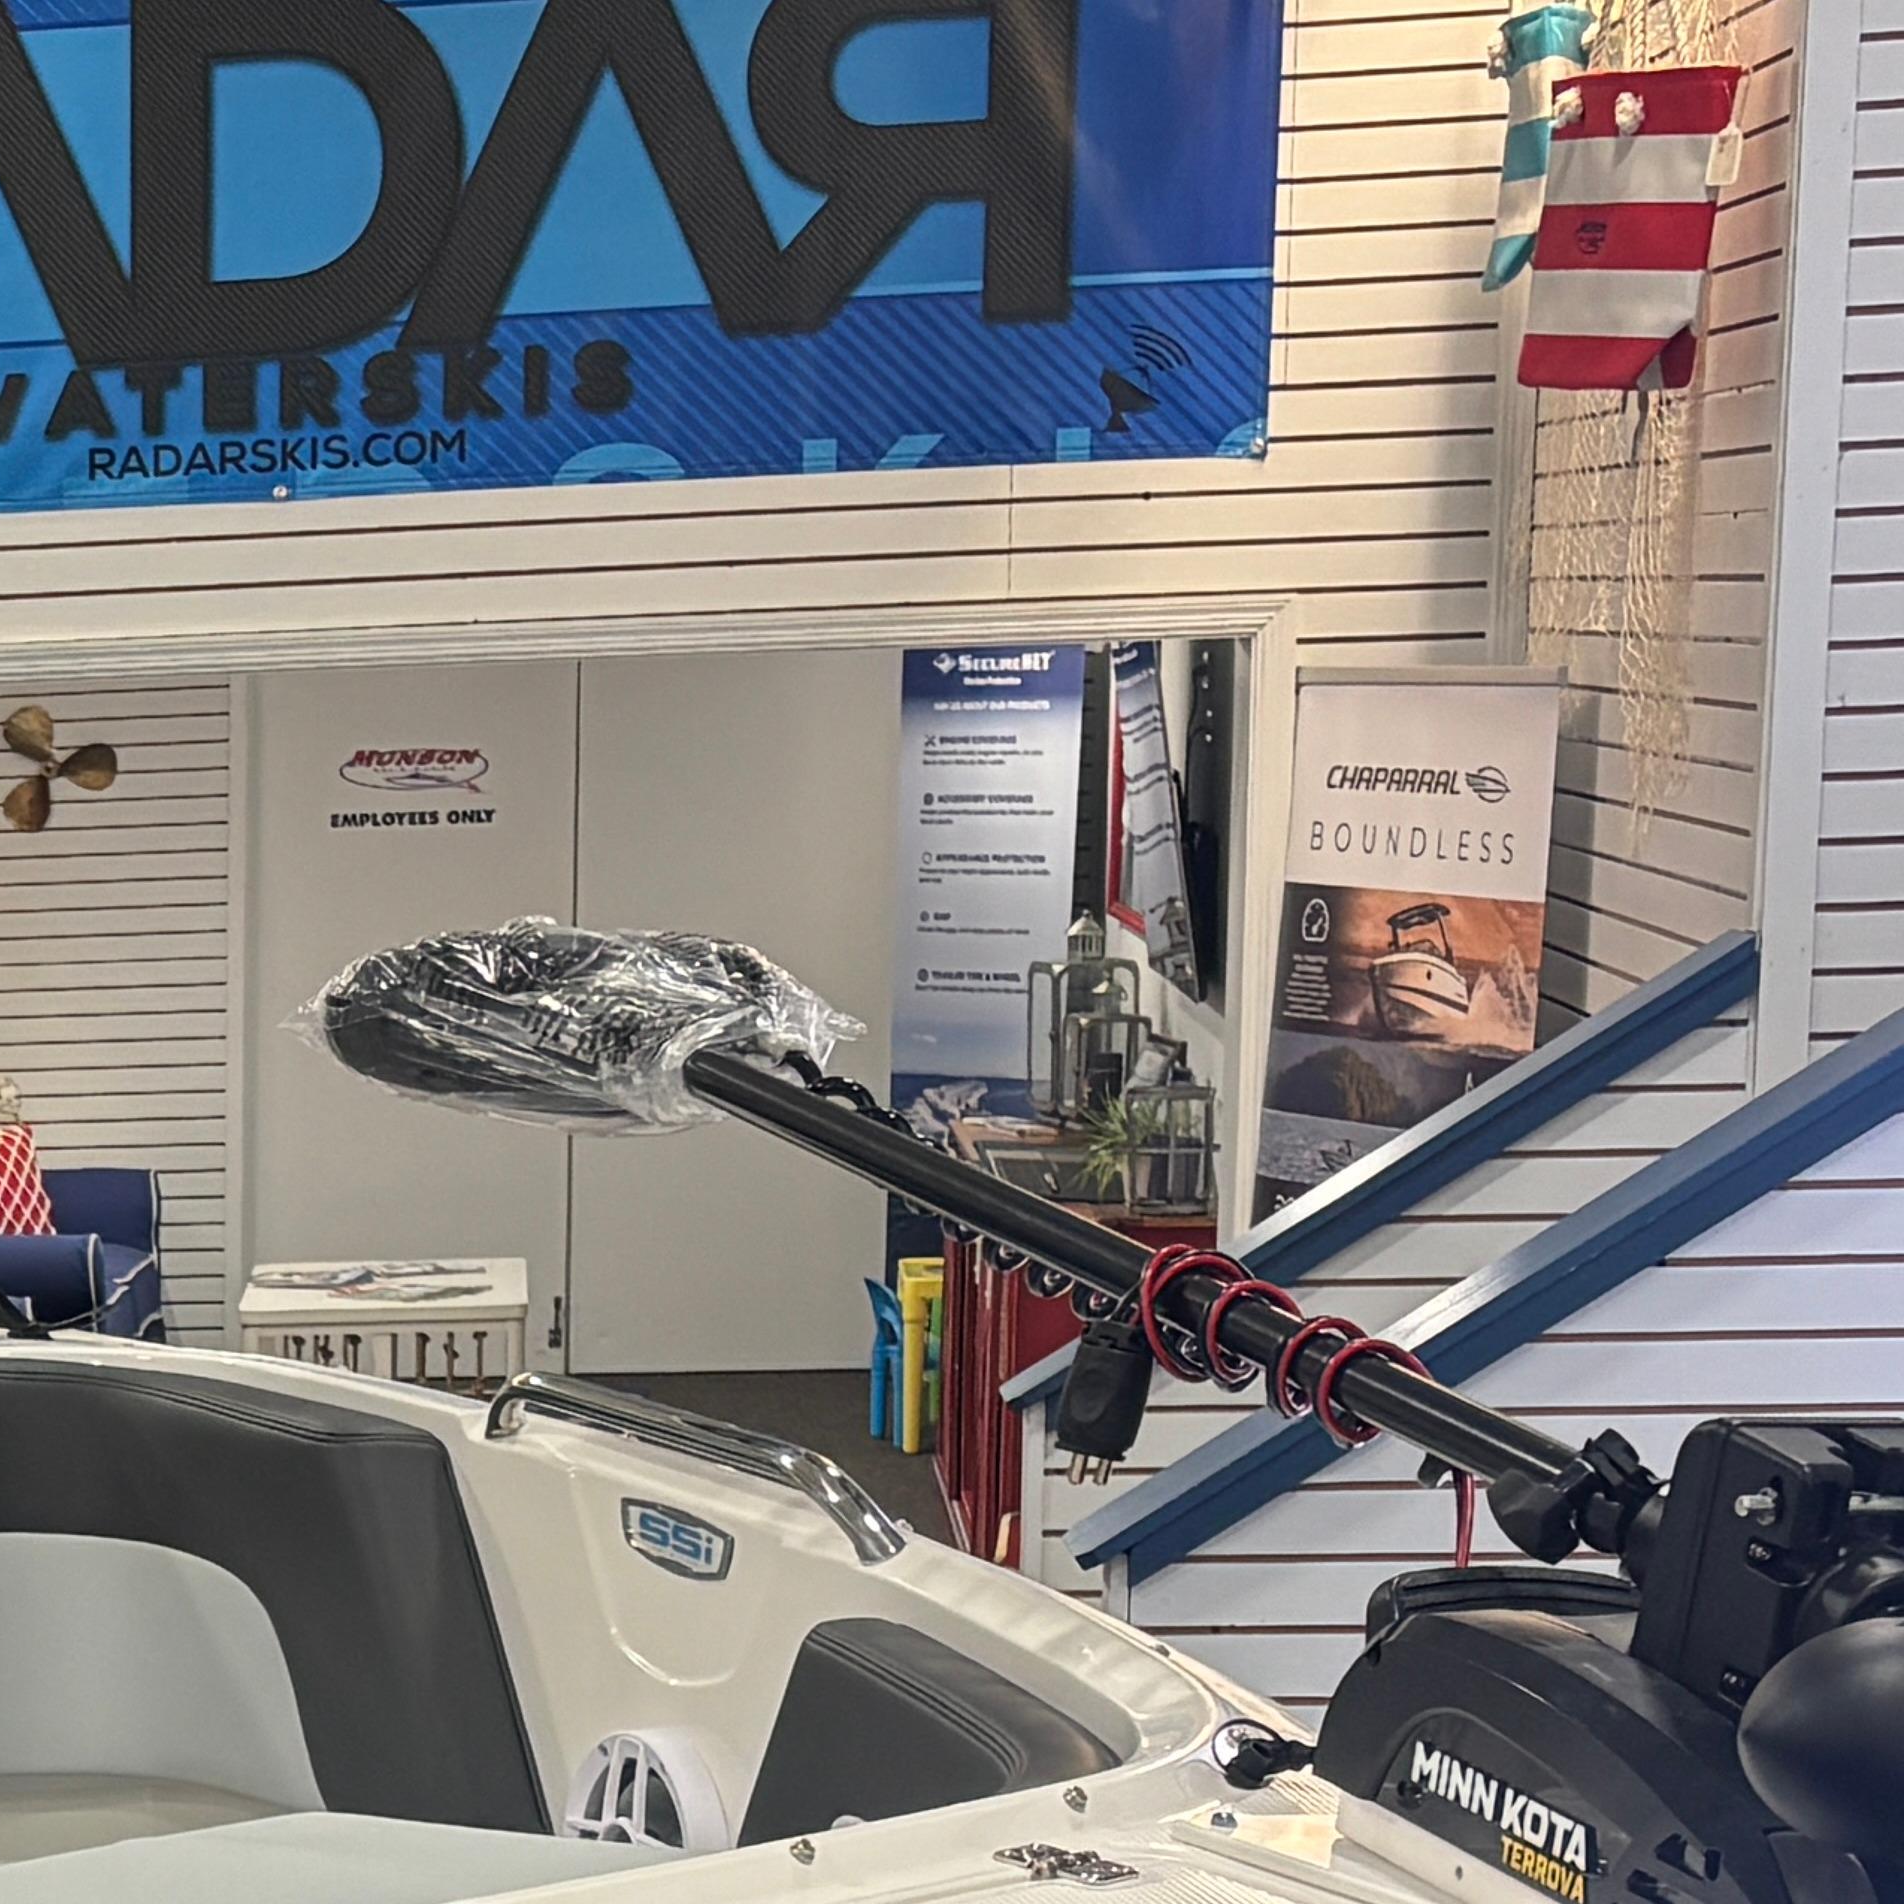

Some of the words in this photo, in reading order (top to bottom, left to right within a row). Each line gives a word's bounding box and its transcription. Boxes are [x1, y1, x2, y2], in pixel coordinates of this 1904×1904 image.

[88, 428, 468, 482] RADARSKIS.COM
[1326, 764, 1462, 796] CHAPARRAL
[330, 811, 439, 828] EMPLOYEES
[446, 809, 495, 824] ONLY
[1310, 820, 1516, 865] BOUNDLESS
[638, 1513, 713, 1565] SSi
[1410, 1740, 1499, 1816] MINN
[1498, 1785, 1589, 1872] KOTA
[1500, 1835, 1587, 1904] TERROVA
